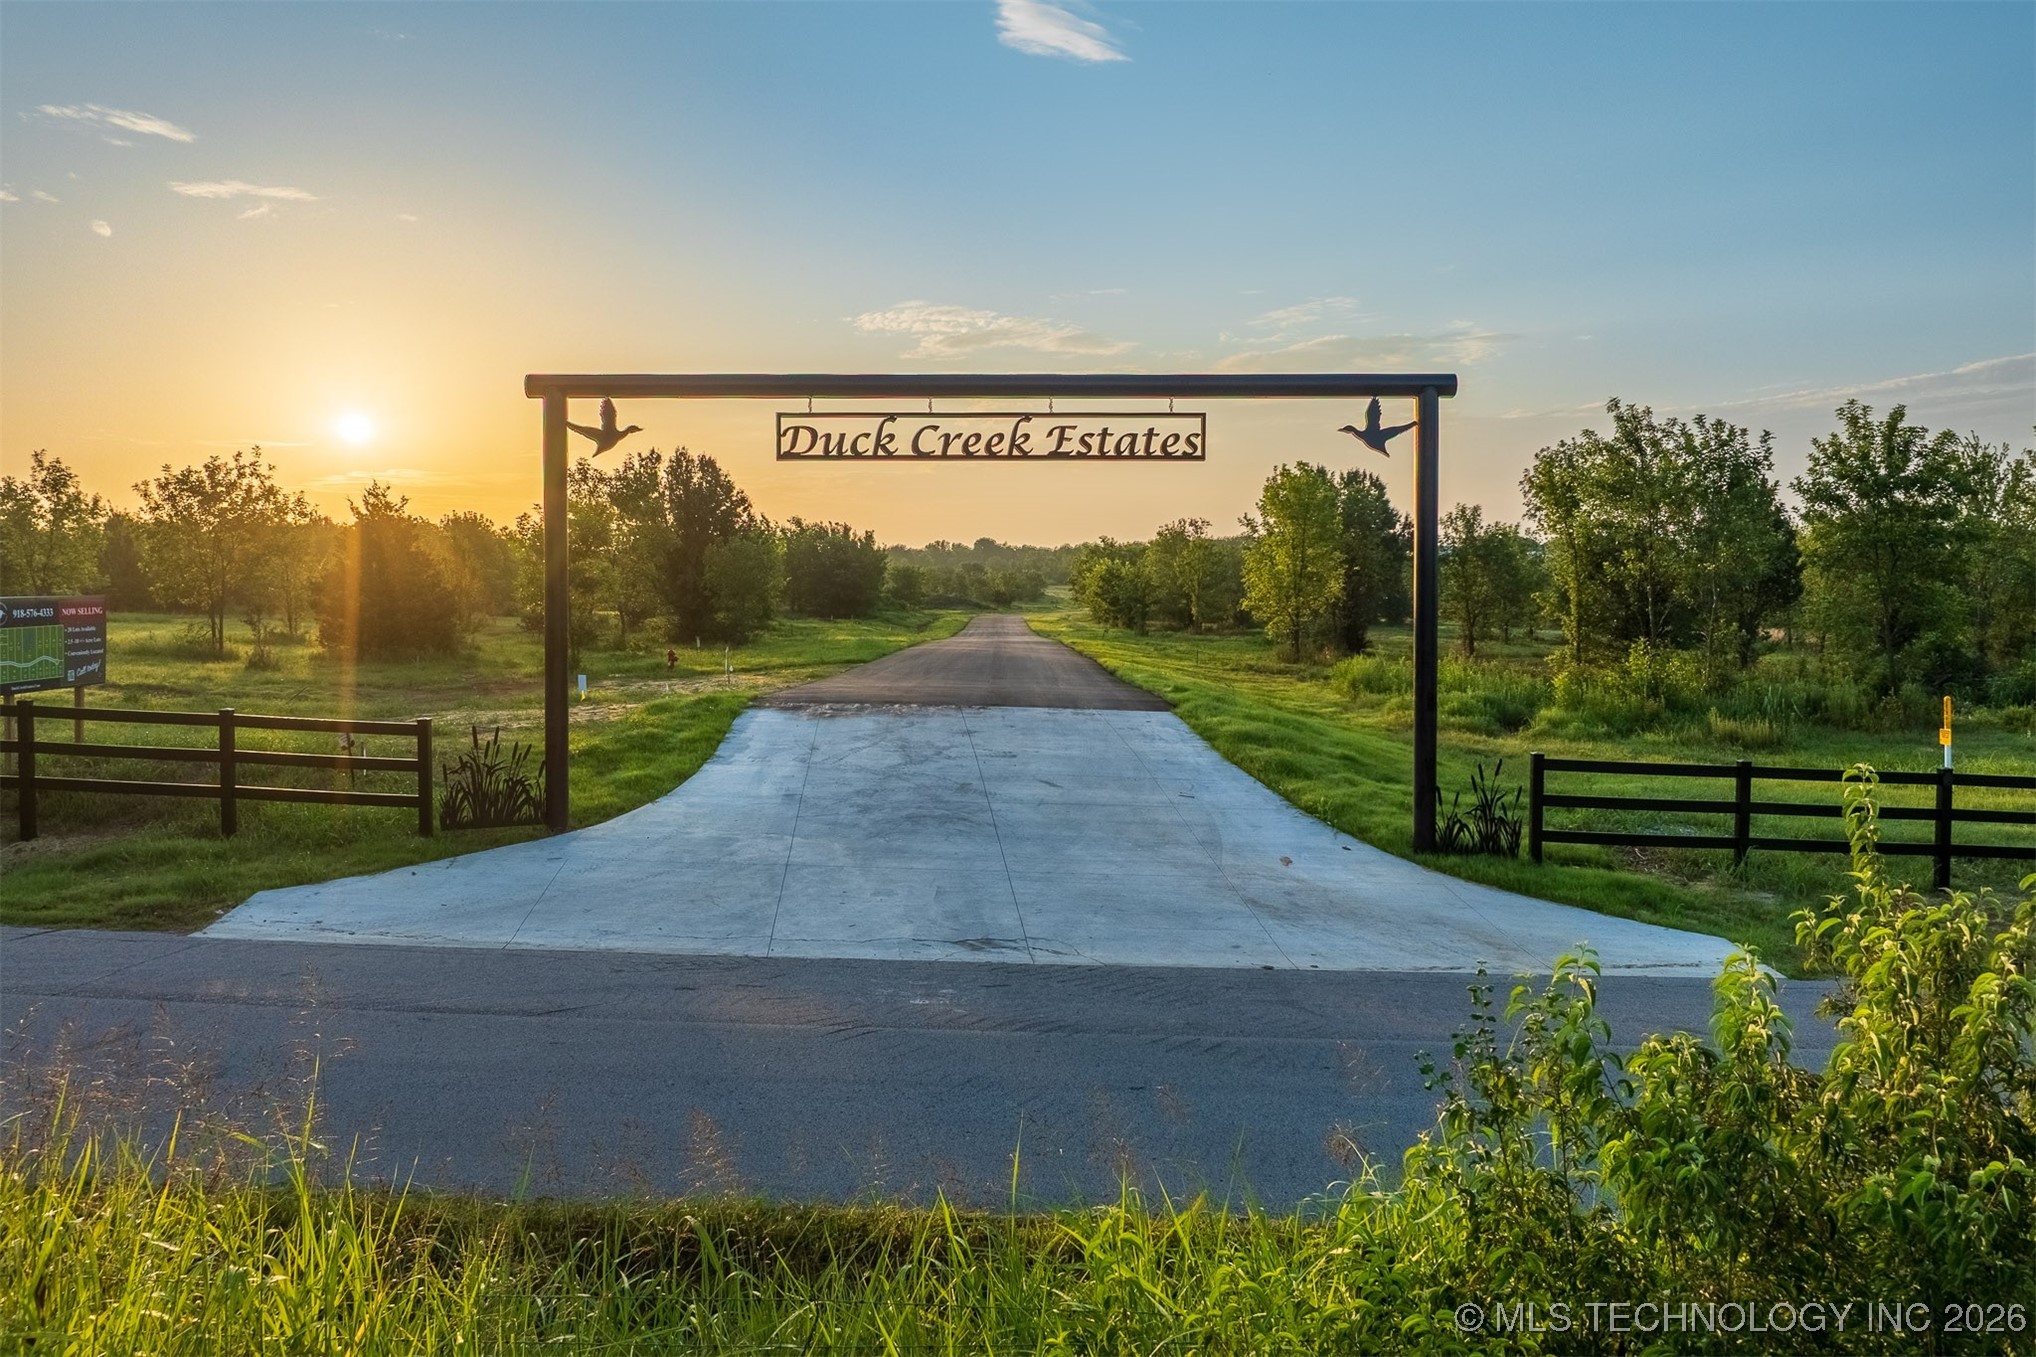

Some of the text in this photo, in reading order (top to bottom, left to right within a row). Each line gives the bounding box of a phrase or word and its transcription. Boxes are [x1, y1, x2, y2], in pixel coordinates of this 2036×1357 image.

[782, 415, 1201, 458] Duck Creek Estates
[12, 607, 54, 618] 918-576-4333
[62, 606, 103, 616] NOW SELLING
